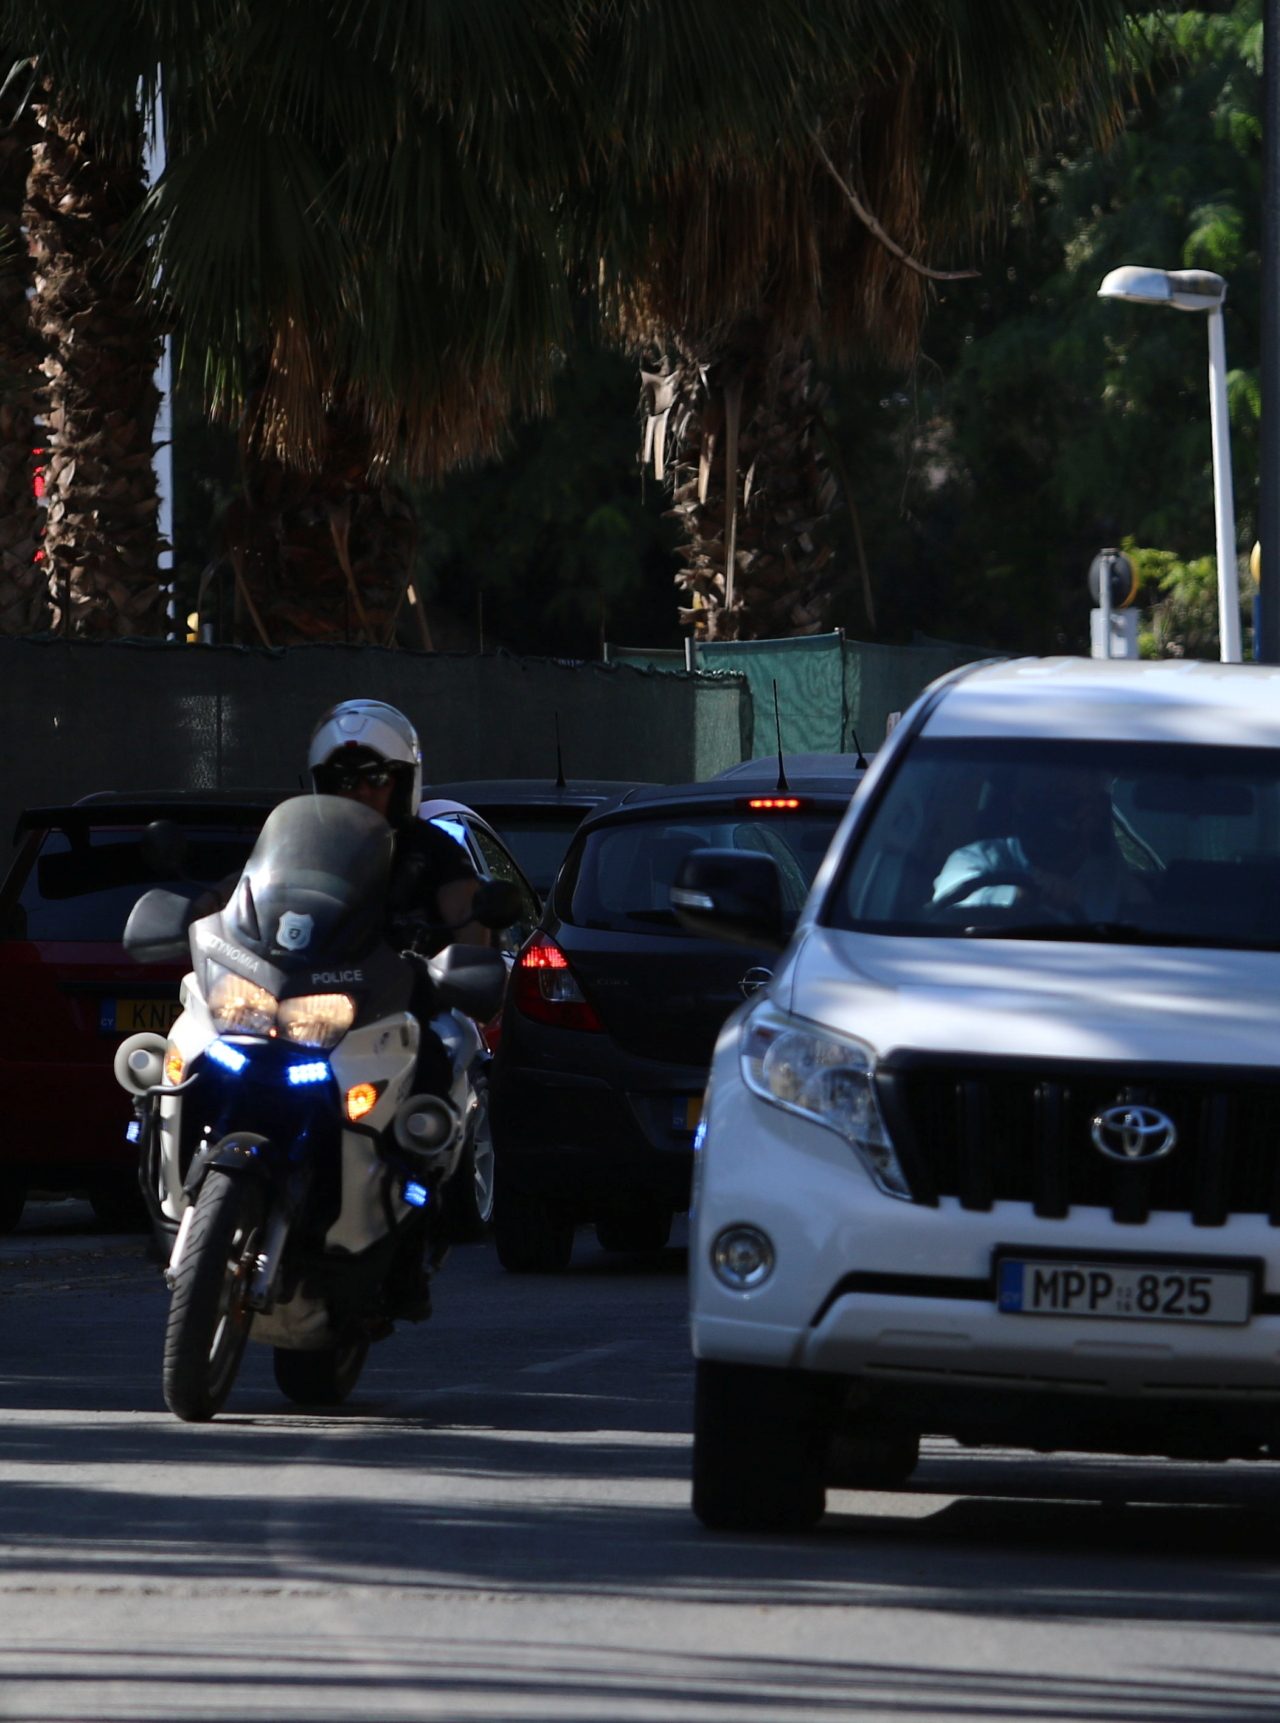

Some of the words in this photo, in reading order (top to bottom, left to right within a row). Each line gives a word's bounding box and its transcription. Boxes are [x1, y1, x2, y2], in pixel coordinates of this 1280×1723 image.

[311, 969, 364, 985] POLICE
[1033, 1268, 1113, 1310] MPP
[1136, 1273, 1213, 1316] 825
